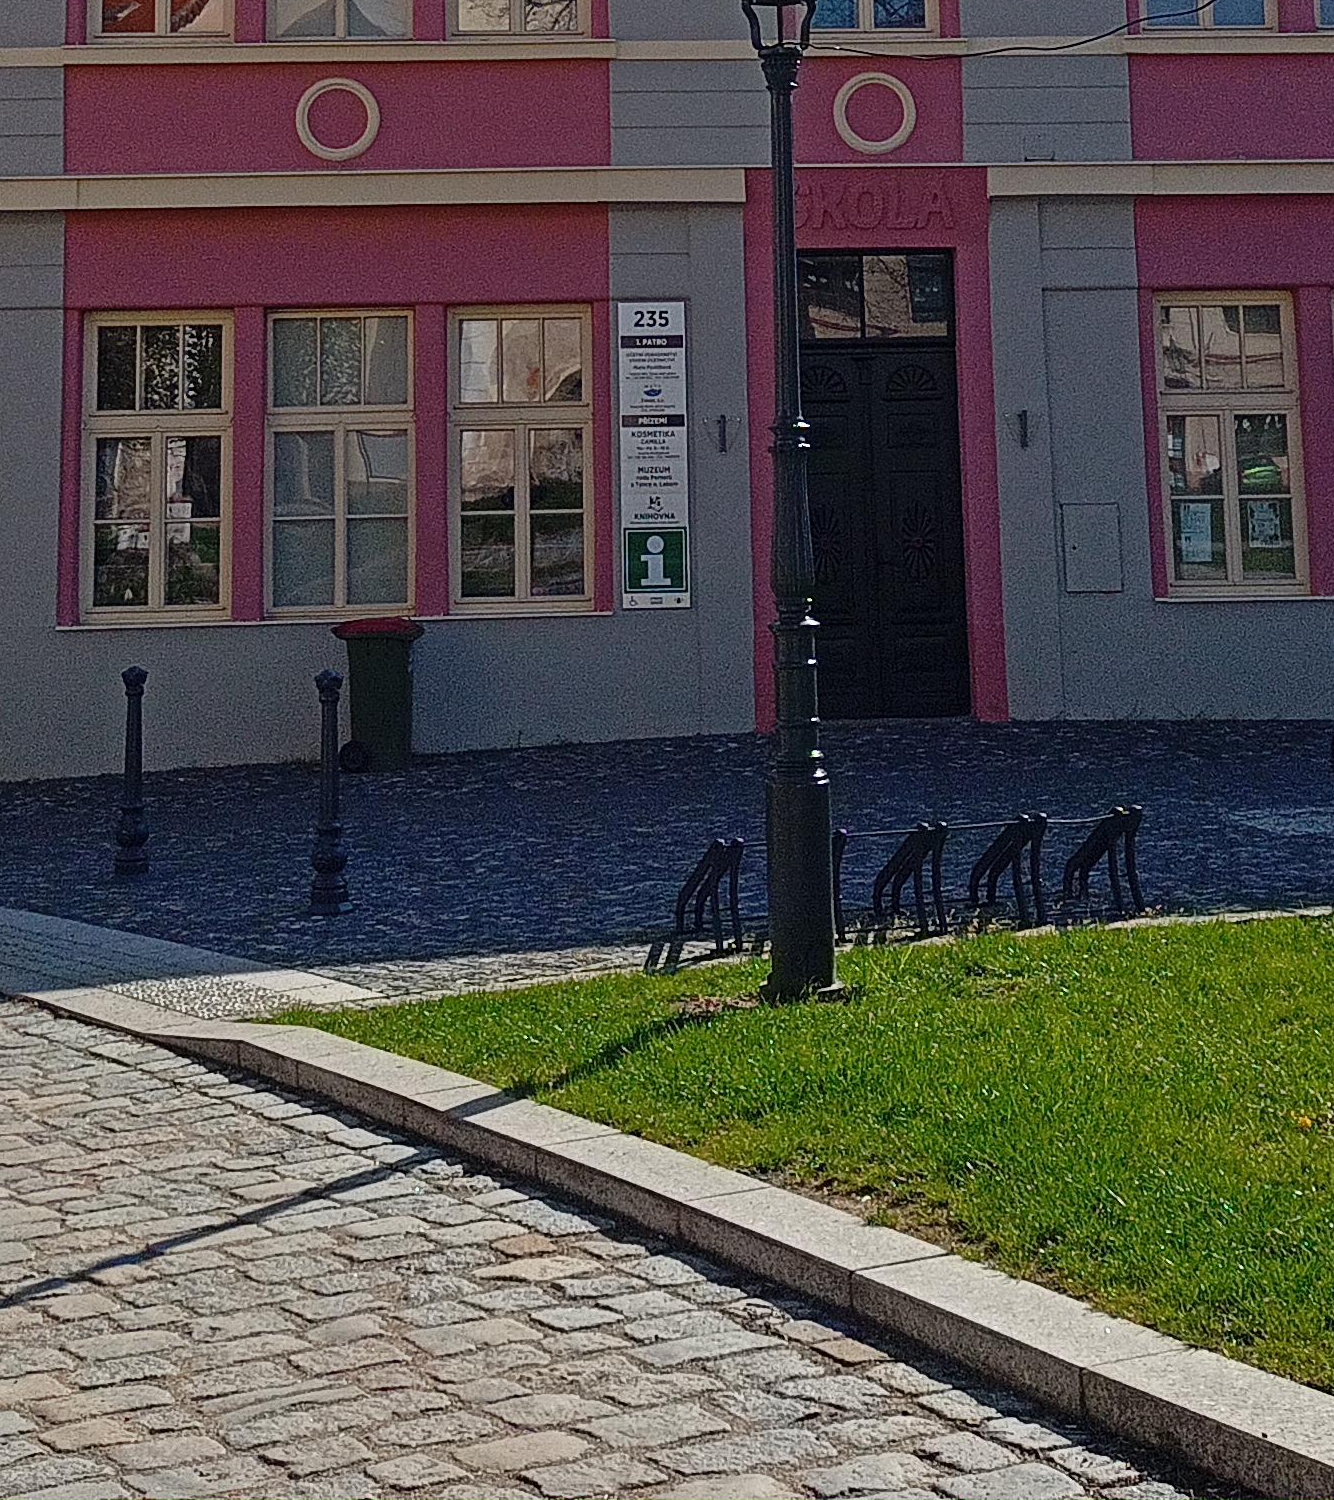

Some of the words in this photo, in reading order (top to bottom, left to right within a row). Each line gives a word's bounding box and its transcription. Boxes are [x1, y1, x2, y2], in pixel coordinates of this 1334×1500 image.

[634, 310, 670, 328] 235
[642, 338, 668, 346] PATRO
[631, 430, 676, 438] KOSMETIKA
[637, 466, 671, 474] MUZEUM
[634, 512, 676, 520] KNIHOVNA
